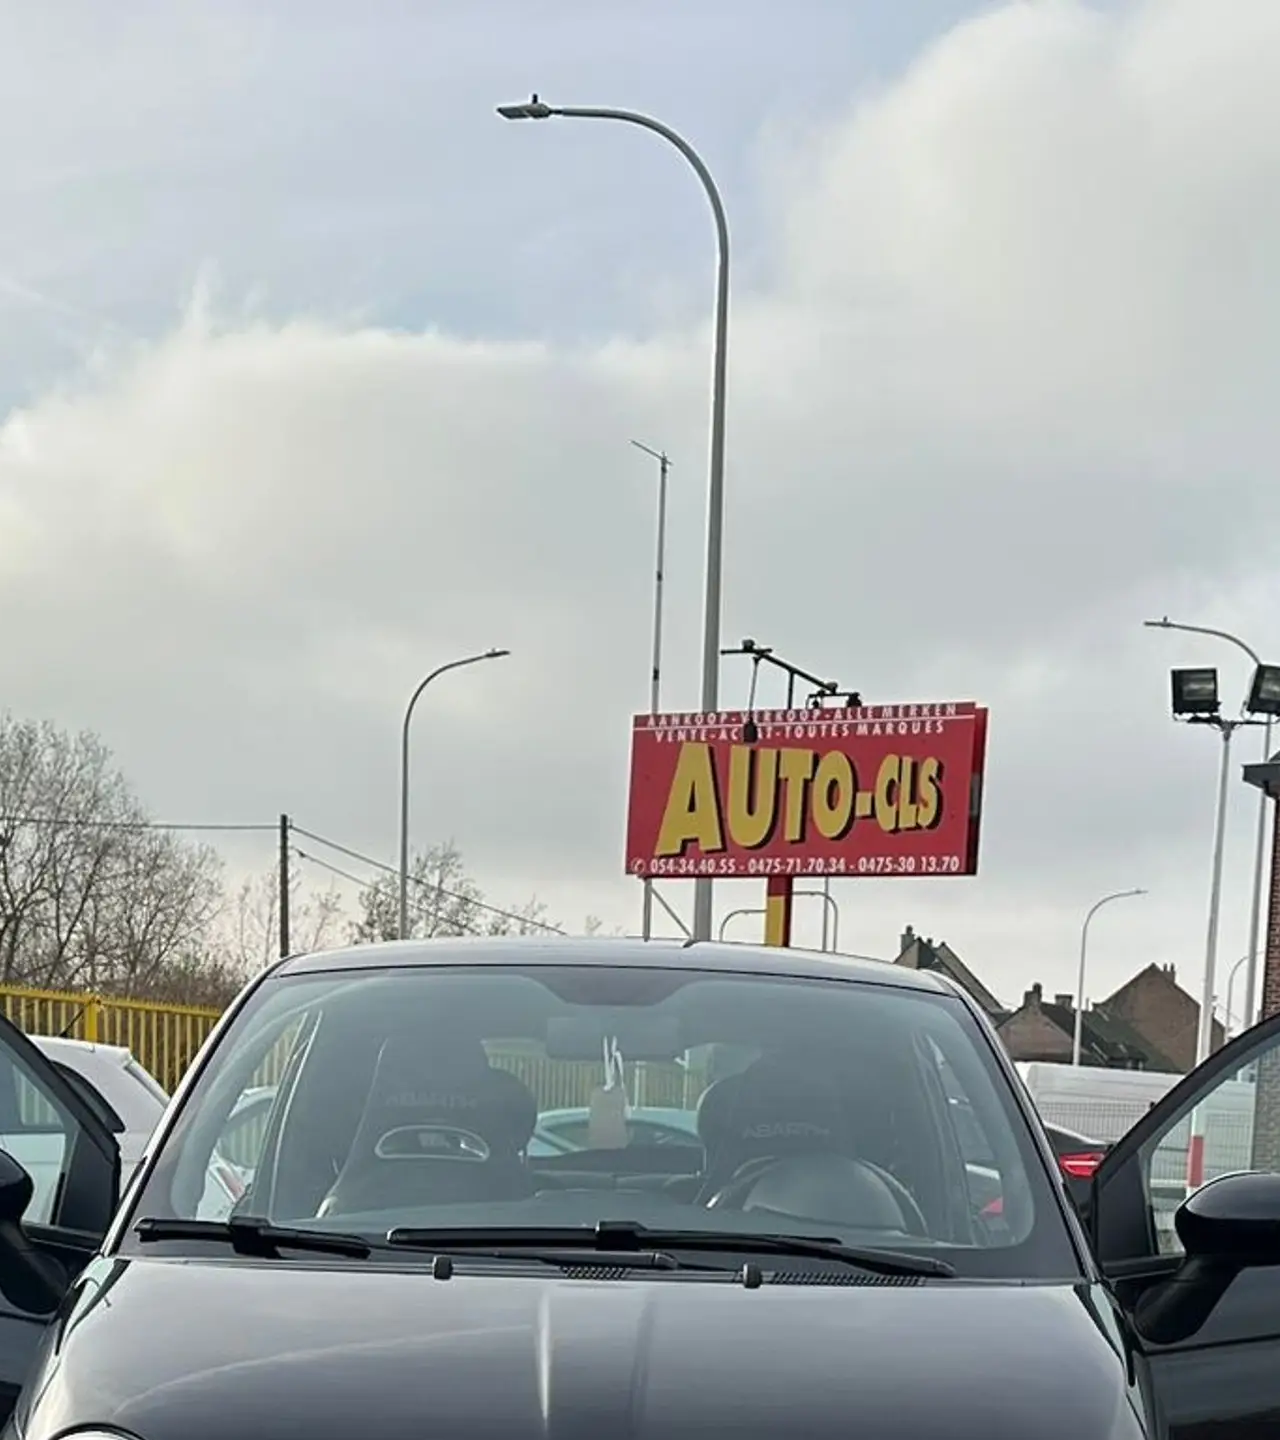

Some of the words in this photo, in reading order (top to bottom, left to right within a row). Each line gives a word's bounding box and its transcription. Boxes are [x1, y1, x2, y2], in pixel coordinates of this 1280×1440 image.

[882, 704, 957, 719] MERKEN
[654, 724, 849, 743] VENTE-ACAT-TOUTES
[855, 720, 945, 736] MARQUES
[654, 741, 940, 858] AUTO-CLS
